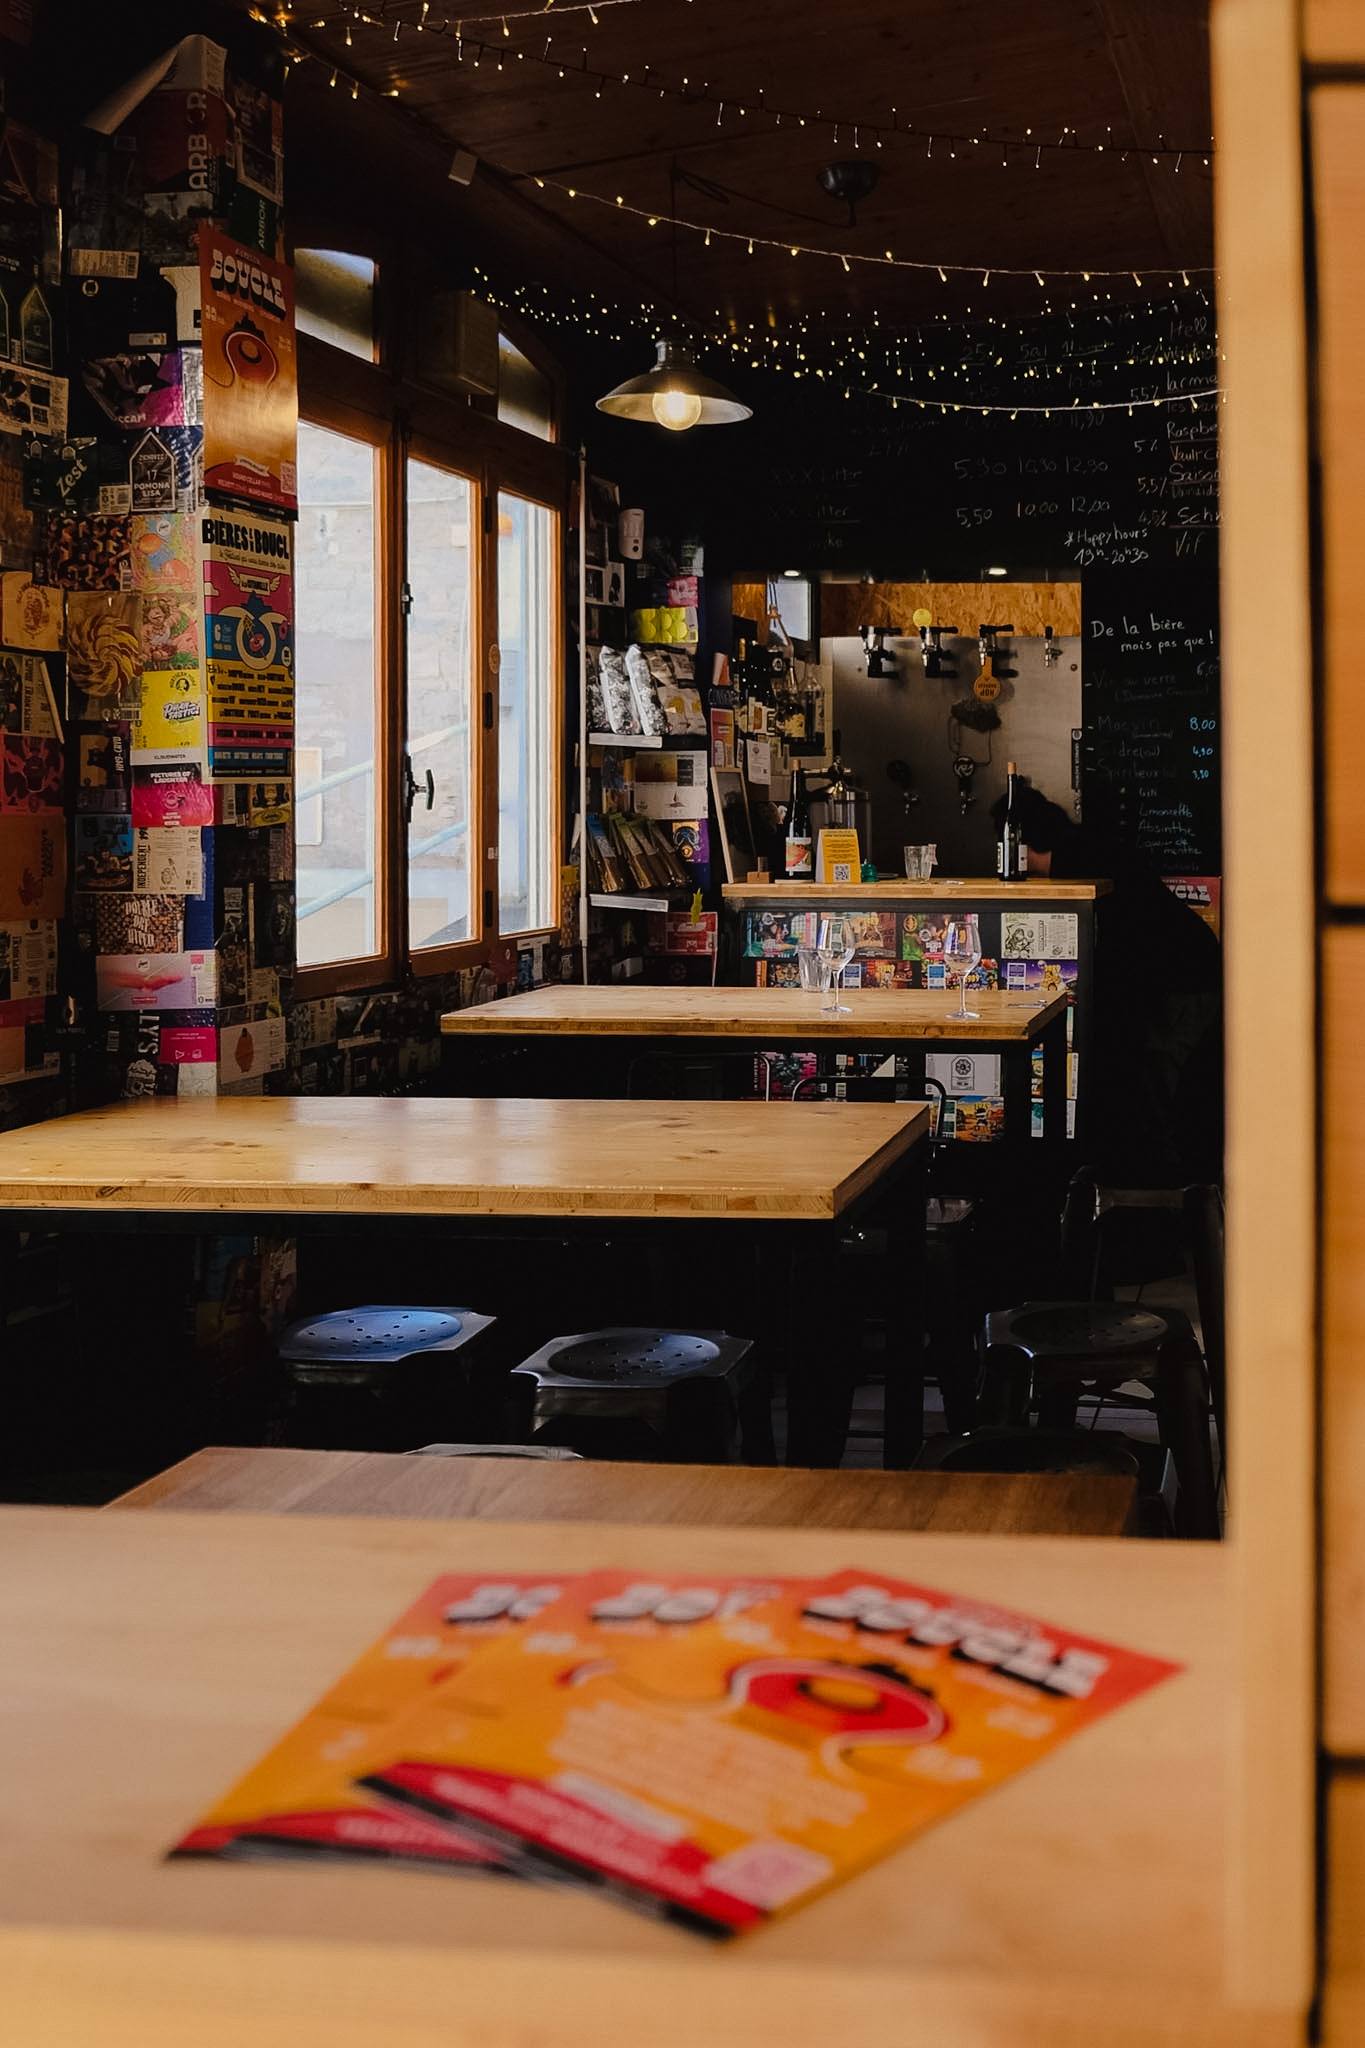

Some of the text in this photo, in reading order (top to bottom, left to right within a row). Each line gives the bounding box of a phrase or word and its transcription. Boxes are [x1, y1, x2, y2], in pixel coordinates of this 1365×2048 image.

[210, 248, 287, 315] BOUCLE
[56, 459, 88, 496] Zest
[147, 469, 157, 481] 17
[134, 482, 171, 492] POMONA
[202, 515, 248, 551] BIÈRES
[1113, 522, 1147, 541] hours
[1090, 612, 1184, 639] De la bière
[1158, 640, 1177, 655] pas
[1184, 638, 1205, 653] que
[1189, 716, 1216, 732] 8,00
[137, 844, 147, 889] INDEPENDENT
